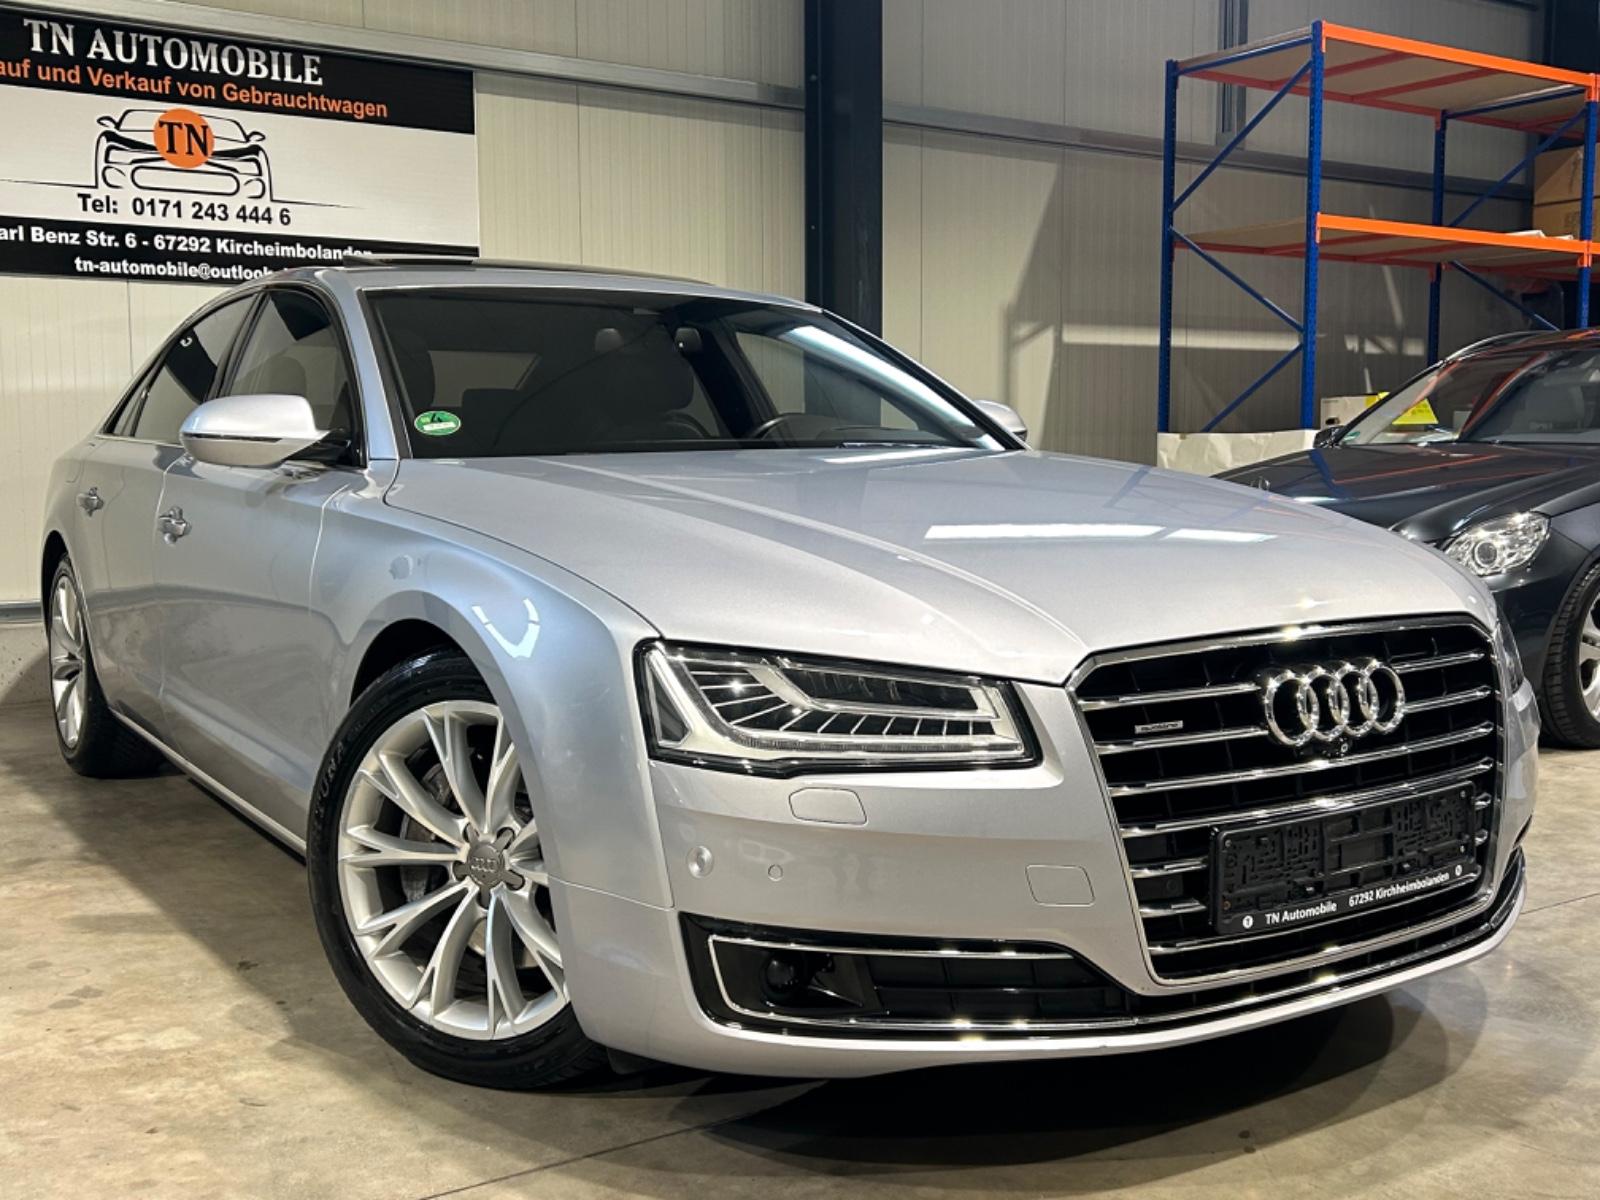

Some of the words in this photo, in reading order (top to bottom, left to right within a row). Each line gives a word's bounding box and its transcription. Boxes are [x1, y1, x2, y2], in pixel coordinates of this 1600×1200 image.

[23, 18, 75, 57] TN
[86, 28, 323, 86] AUTOMOBILE
[37, 64, 81, 85] und
[86, 66, 173, 95] Verkauf
[176, 81, 216, 99] von
[221, 82, 389, 119] Gebrauchtwagen
[158, 120, 209, 157] TN
[77, 193, 118, 214] Tel:
[132, 197, 182, 218] 0171
[191, 201, 229, 222] 243
[236, 204, 272, 225] 444
[279, 207, 291, 226] 6
[30, 226, 81, 245] Benz
[86, 229, 120, 248] Str.
[124, 232, 137, 249] 6
[154, 234, 211, 253] 67292
[1264, 912, 1280, 925] TN
[1281, 901, 1338, 922] Automobile
[1348, 890, 1374, 907] 67292
